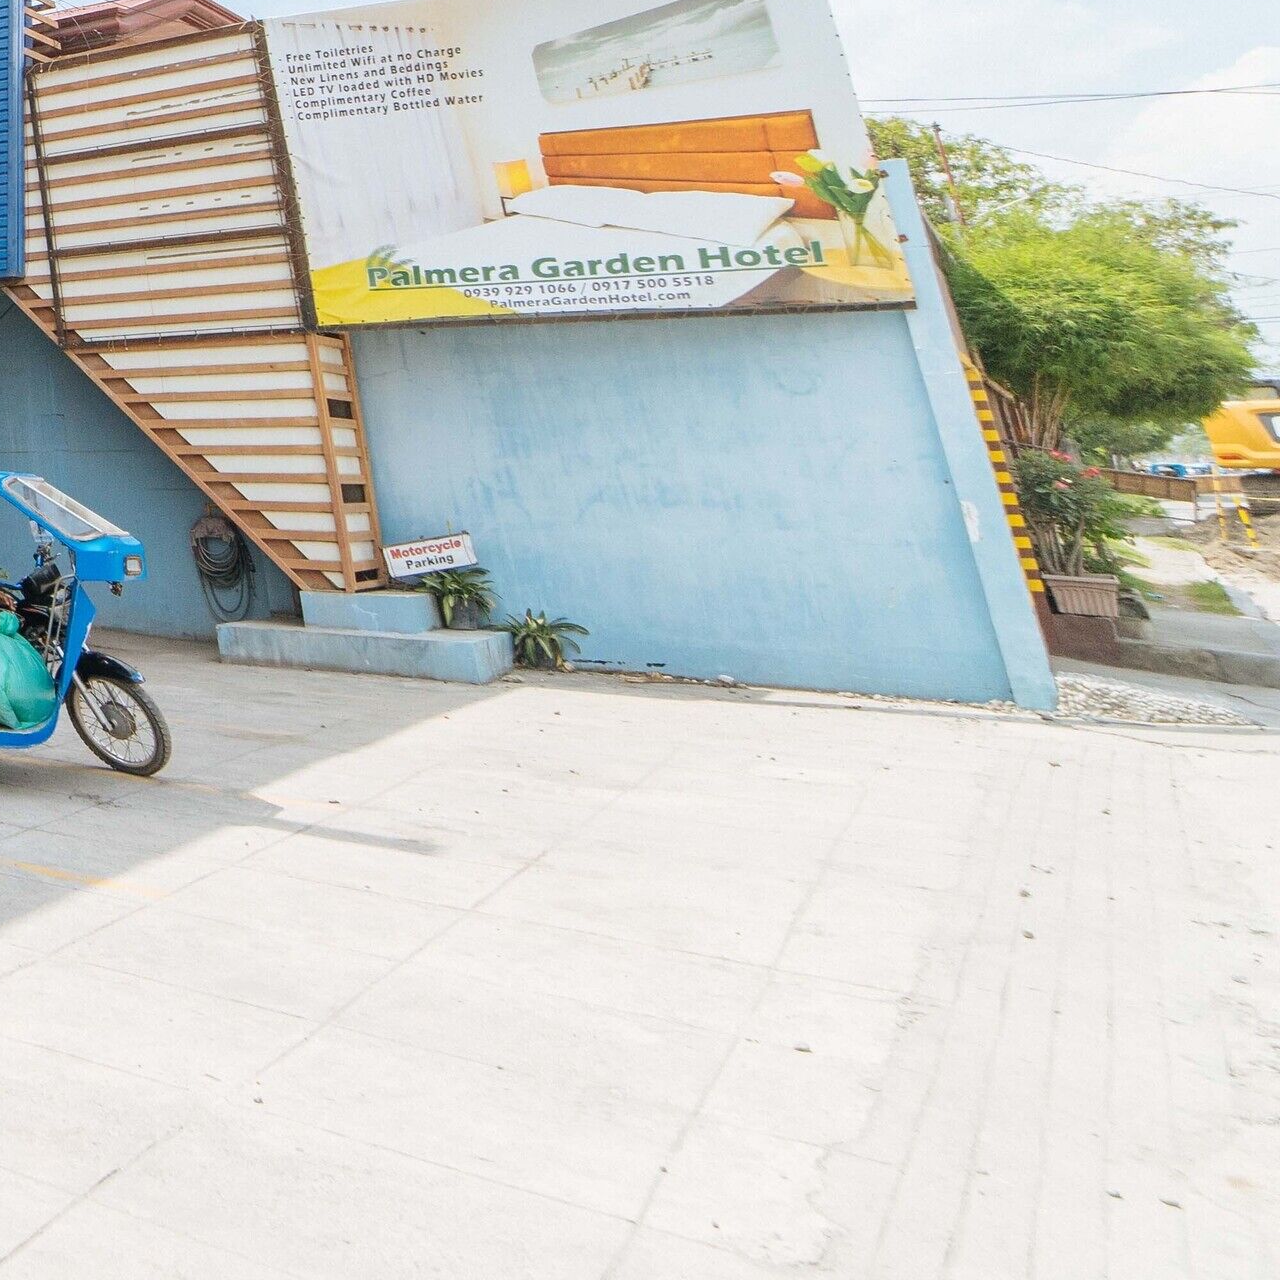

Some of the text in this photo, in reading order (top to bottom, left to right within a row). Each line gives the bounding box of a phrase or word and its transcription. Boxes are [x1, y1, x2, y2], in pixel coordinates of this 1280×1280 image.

[285, 43, 375, 63] Free Toiletries
[287, 44, 462, 75] Unlimited Wifi at no Charge
[290, 58, 450, 87] New Linens and Beddings
[292, 67, 485, 99] LED TV loaded with HD Movies
[294, 85, 432, 111] Complimentary Coffee
[297, 92, 484, 122] Complimentary Bottled Water
[367, 240, 824, 287] Palmera Garden Hotel
[463, 286, 500, 299] 0939
[505, 284, 533, 296] 929
[538, 282, 576, 294] 1066
[592, 280, 631, 292] 0917
[637, 277, 667, 290] 500
[672, 274, 715, 288] 5518
[490, 290, 691, 309] PalmeraGardenHotel.com
[389, 538, 463, 560] Motorcycle
[405, 554, 455, 570] Parking
